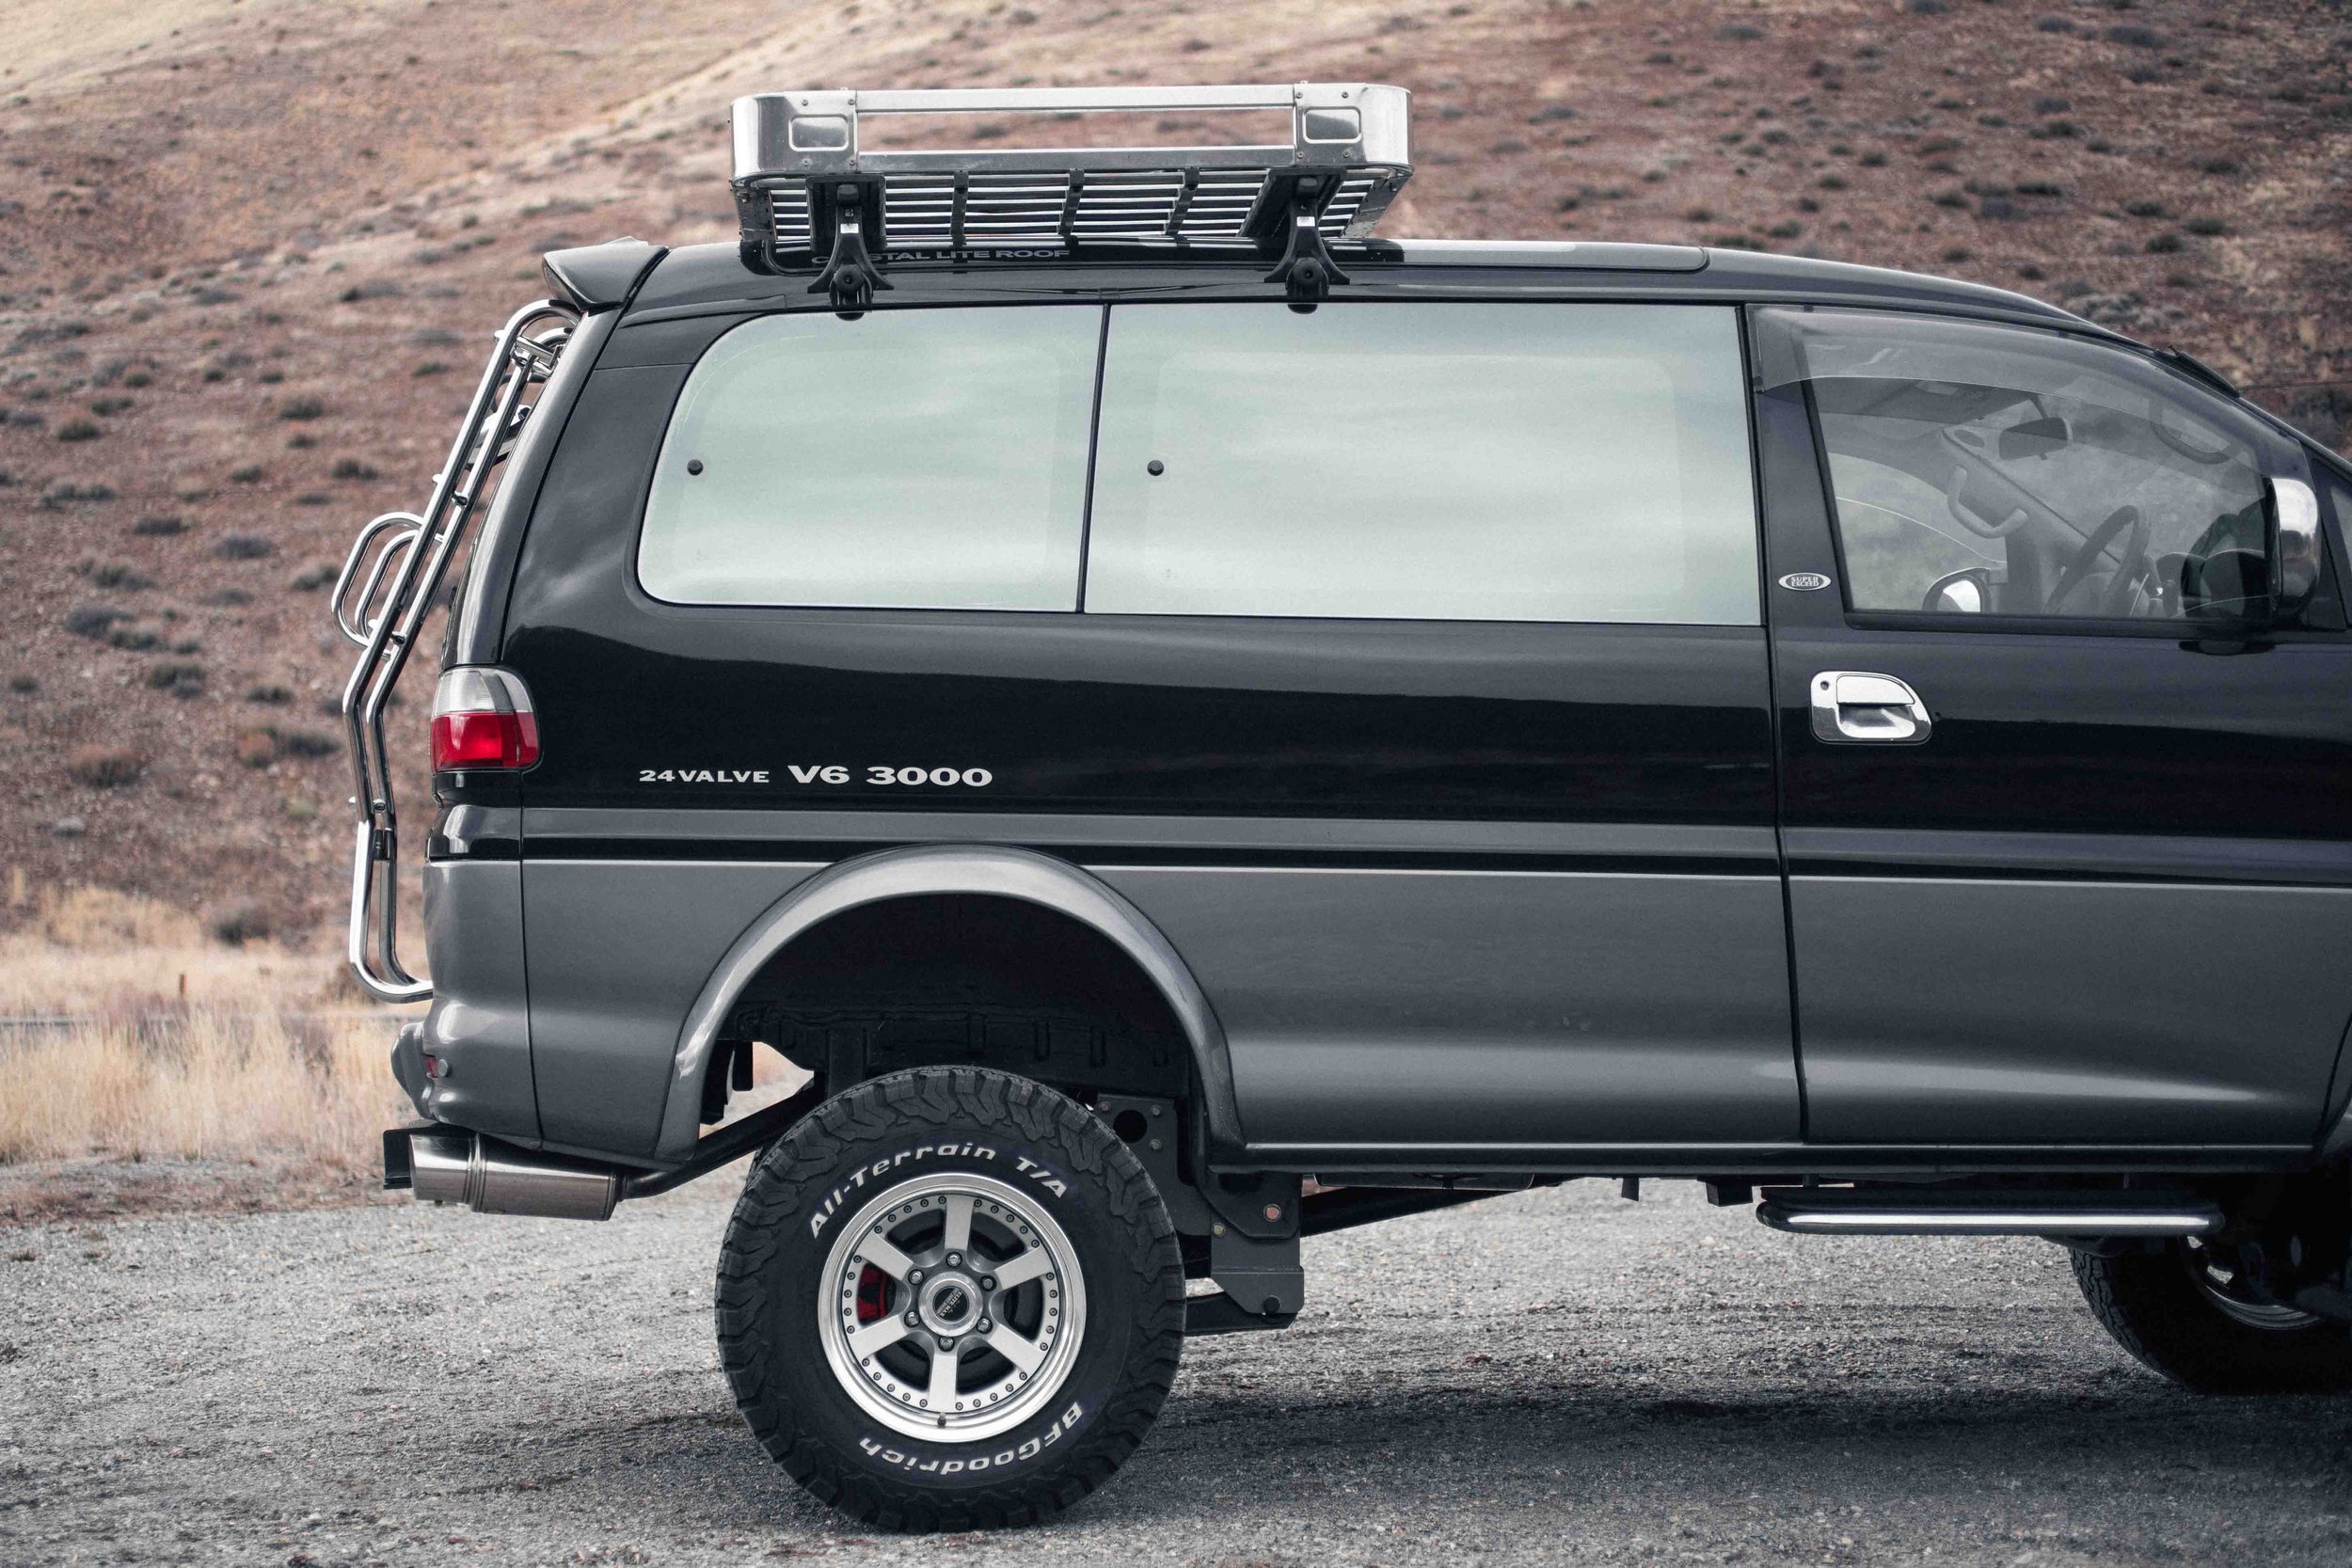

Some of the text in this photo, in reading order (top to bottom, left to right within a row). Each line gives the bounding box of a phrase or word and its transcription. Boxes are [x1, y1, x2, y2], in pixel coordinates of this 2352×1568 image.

[811, 248, 1070, 263] CSTAL LITE ROOF
[787, 765, 850, 784] V6
[866, 766, 993, 786] 3000
[810, 1142, 1068, 1239] All-Terrain T/A
[859, 1402, 1083, 1476] BFGoodrich
